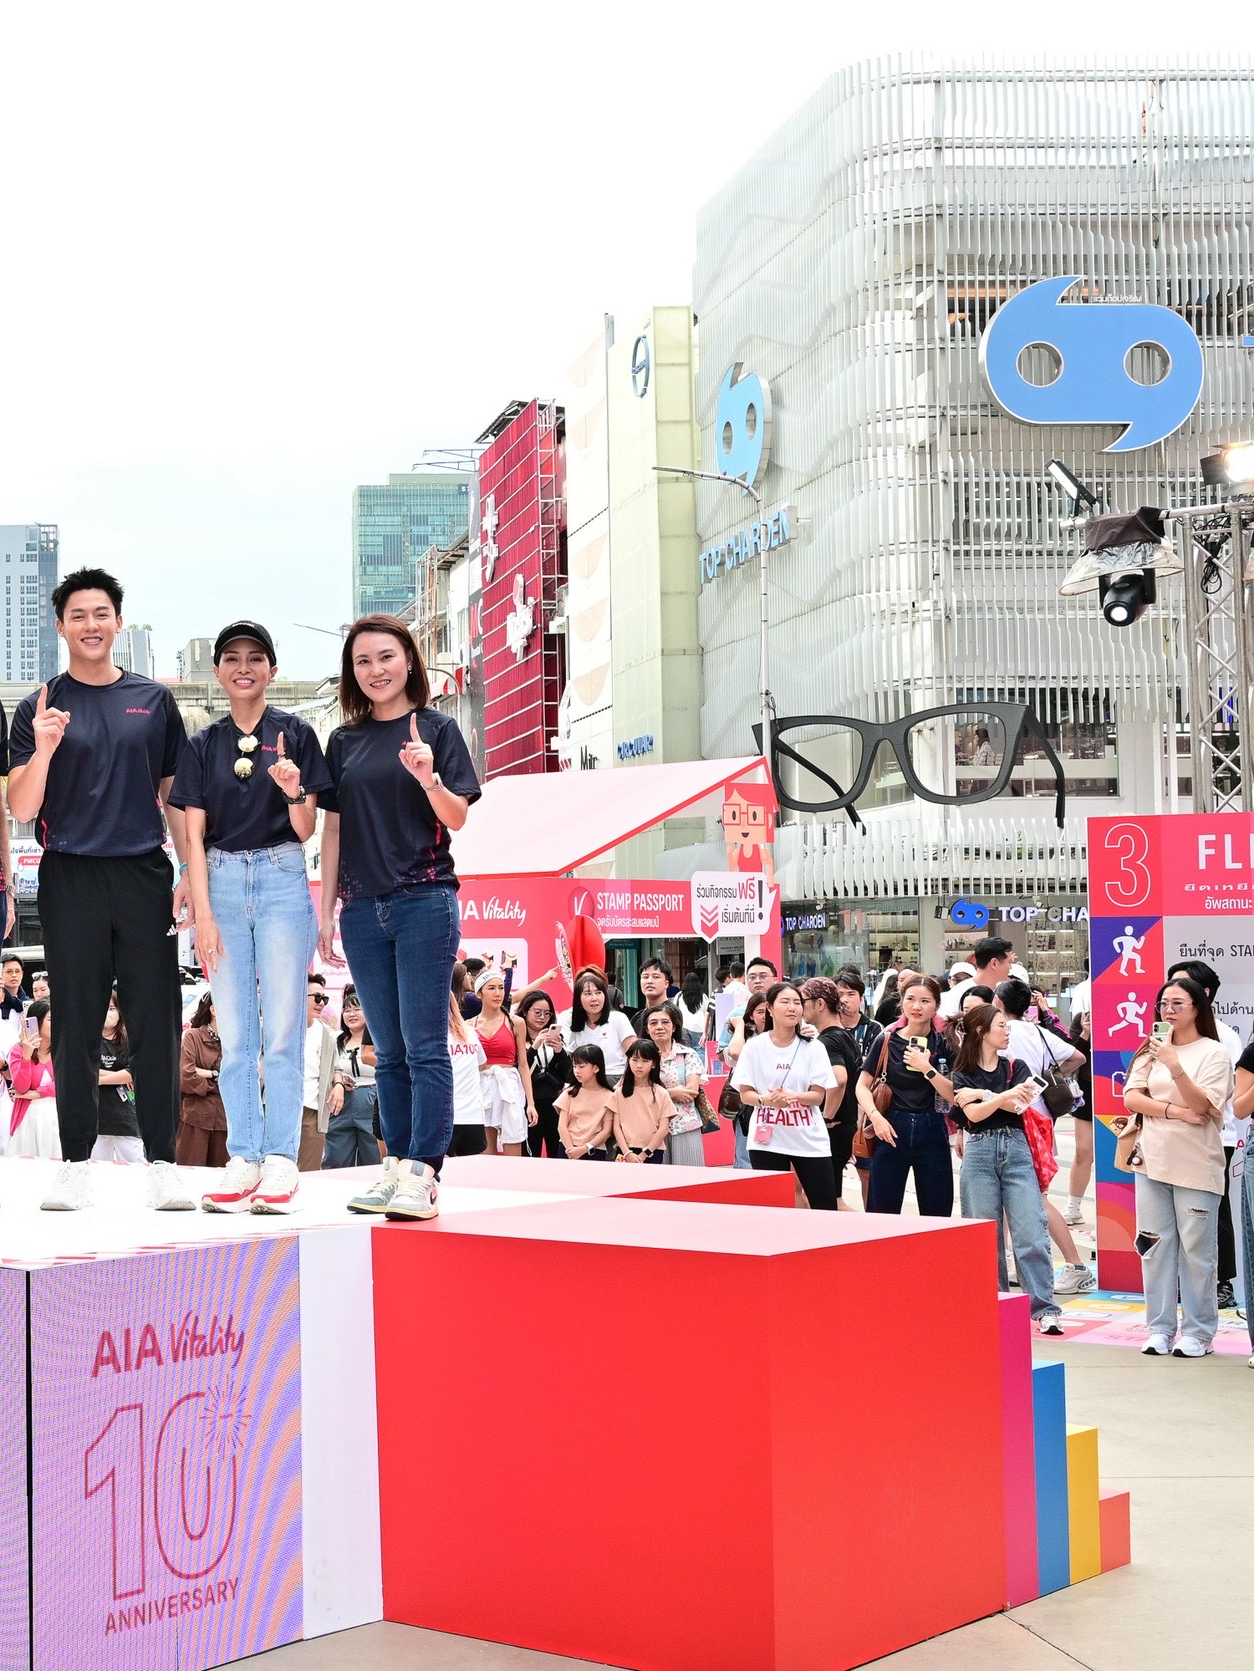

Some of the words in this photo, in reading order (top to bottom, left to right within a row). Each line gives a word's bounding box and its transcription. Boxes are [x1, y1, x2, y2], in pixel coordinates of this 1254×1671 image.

[699, 545, 722, 584] TOP
[1104, 823, 1151, 907] 3
[1198, 834, 1254, 870] FL
[460, 900, 480, 920] IA
[482, 895, 527, 927] Vitality
[597, 892, 632, 910] STAMP
[634, 893, 684, 911] PASSPORT
[998, 906, 1038, 922] TOP
[786, 917, 796, 930] TOP
[798, 912, 826, 930] CHAROEN
[1230, 944, 1254, 957] STA
[91, 1324, 163, 1378] AIA
[170, 1309, 246, 1369] Vitality
[84, 1391, 237, 1601] 10
[105, 1577, 240, 1637] ANNIVERSARY
